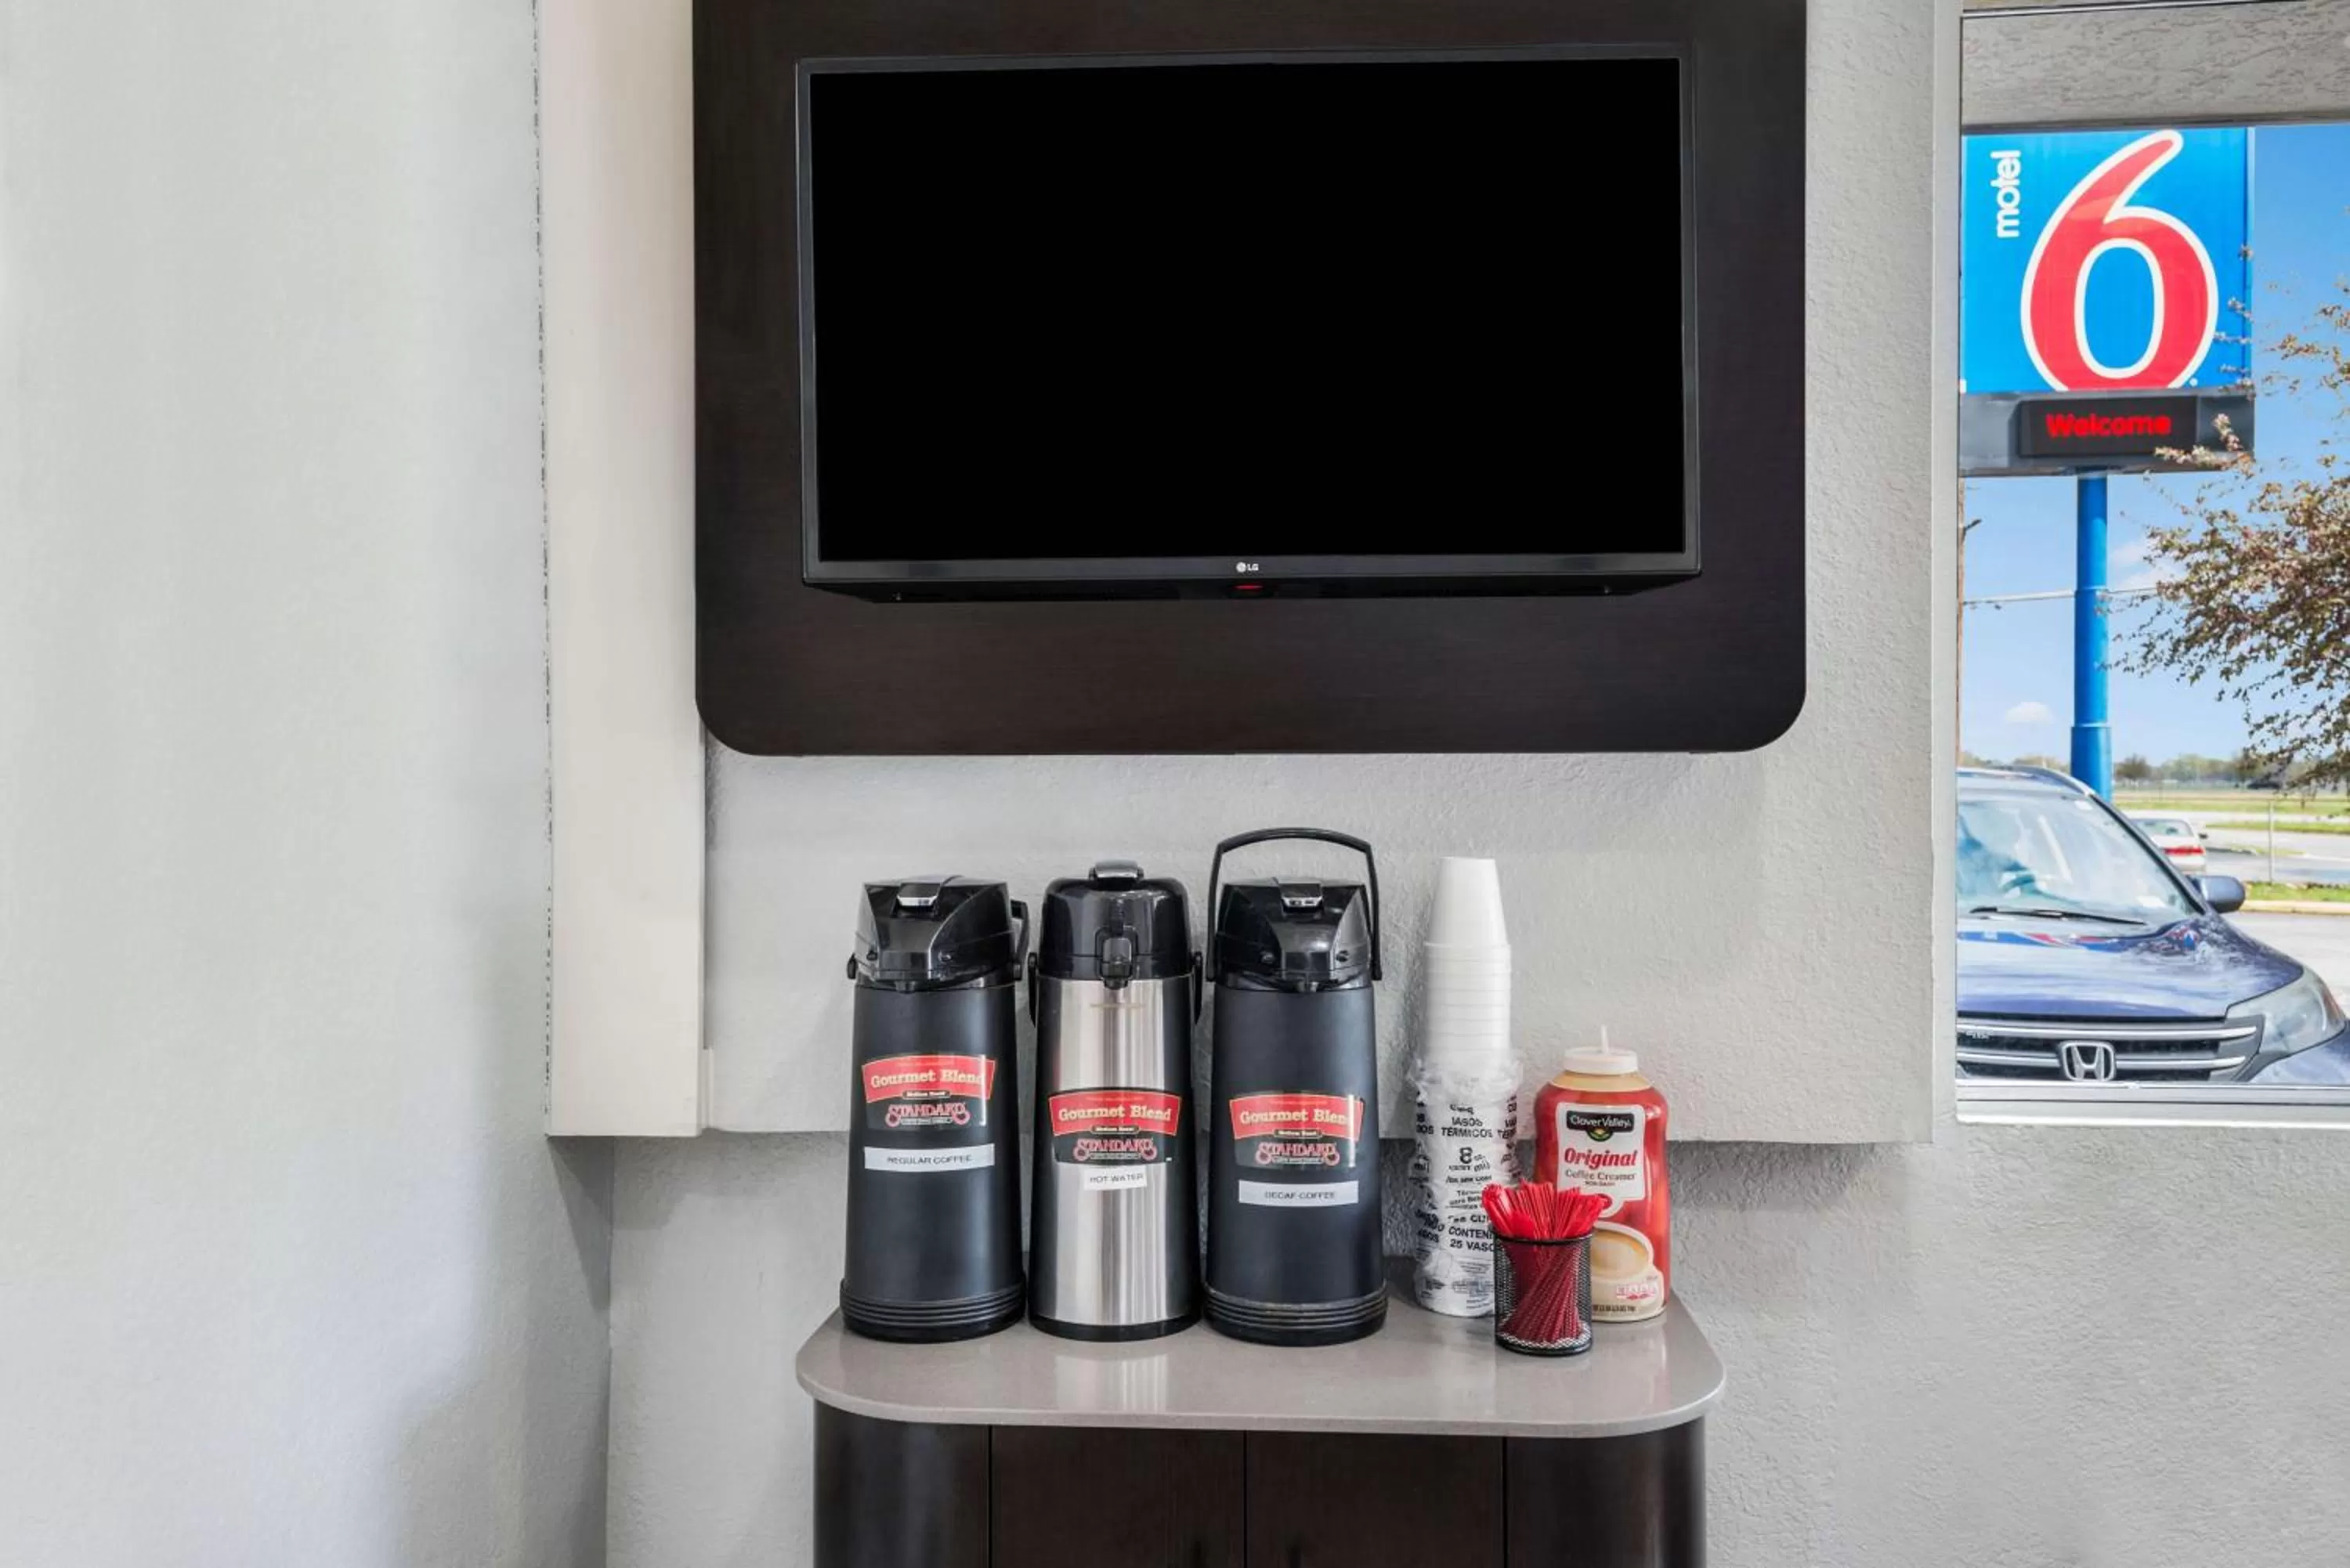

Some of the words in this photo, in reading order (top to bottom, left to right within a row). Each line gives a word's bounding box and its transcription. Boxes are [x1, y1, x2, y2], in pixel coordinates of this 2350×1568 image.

[1990, 150, 2021, 238] motel
[2020, 129, 2219, 392] 6
[2046, 413, 2171, 438] Welcome
[871, 1069, 936, 1088] Gourmet
[885, 1102, 971, 1127] STANDARD
[1059, 1105, 1125, 1122] Gourmet
[1130, 1105, 1171, 1122] Blend
[1240, 1109, 1308, 1125] Gourmet
[1313, 1109, 1352, 1125] Blen
[1570, 1115, 1600, 1126] Clover
[1602, 1116, 1631, 1129] Valley
[1072, 1137, 1158, 1162] STANDARD
[1256, 1141, 1340, 1166] STANDARD
[1459, 1147, 1473, 1164] 8
[887, 1157, 931, 1165] REGULAR
[932, 1154, 972, 1165] COFFEE
[1564, 1148, 1638, 1169] Original
[1090, 1175, 1108, 1183] HOT
[1110, 1173, 1144, 1183] WATER
[1565, 1169, 1594, 1180] Coffee
[1597, 1171, 1636, 1181] Creamer
[1298, 1190, 1335, 1199] COFFEE
[1449, 1239, 1462, 1249] 25
[1466, 1241, 1495, 1252] VASO
